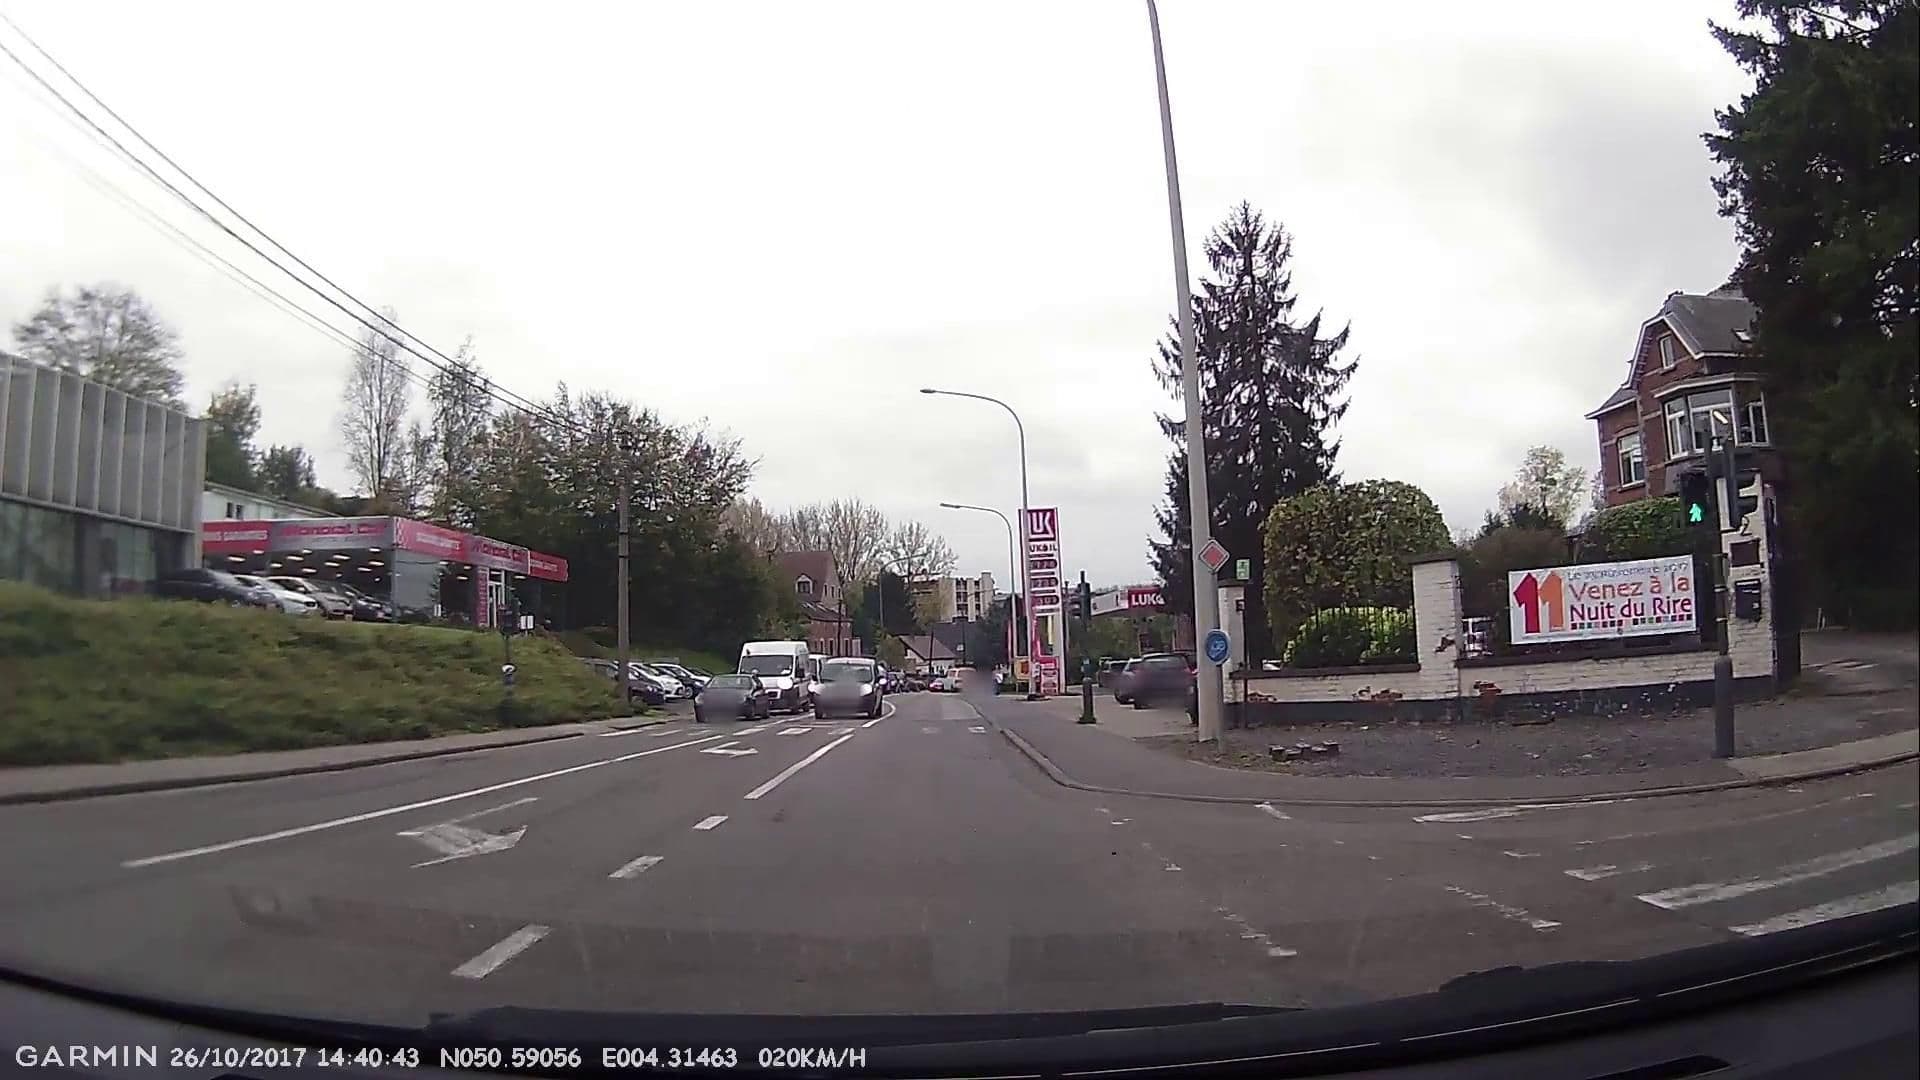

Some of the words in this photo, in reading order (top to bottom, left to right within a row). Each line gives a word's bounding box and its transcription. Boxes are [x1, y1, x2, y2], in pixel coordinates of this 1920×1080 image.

[1568, 581, 1643, 601] Venez
[1650, 575, 1662, 594] à
[1672, 571, 1690, 593] la
[1131, 592, 1166, 606] LUKO
[1570, 601, 1615, 621] Nuit
[1620, 598, 1645, 618] du
[1652, 596, 1692, 616] Rire
